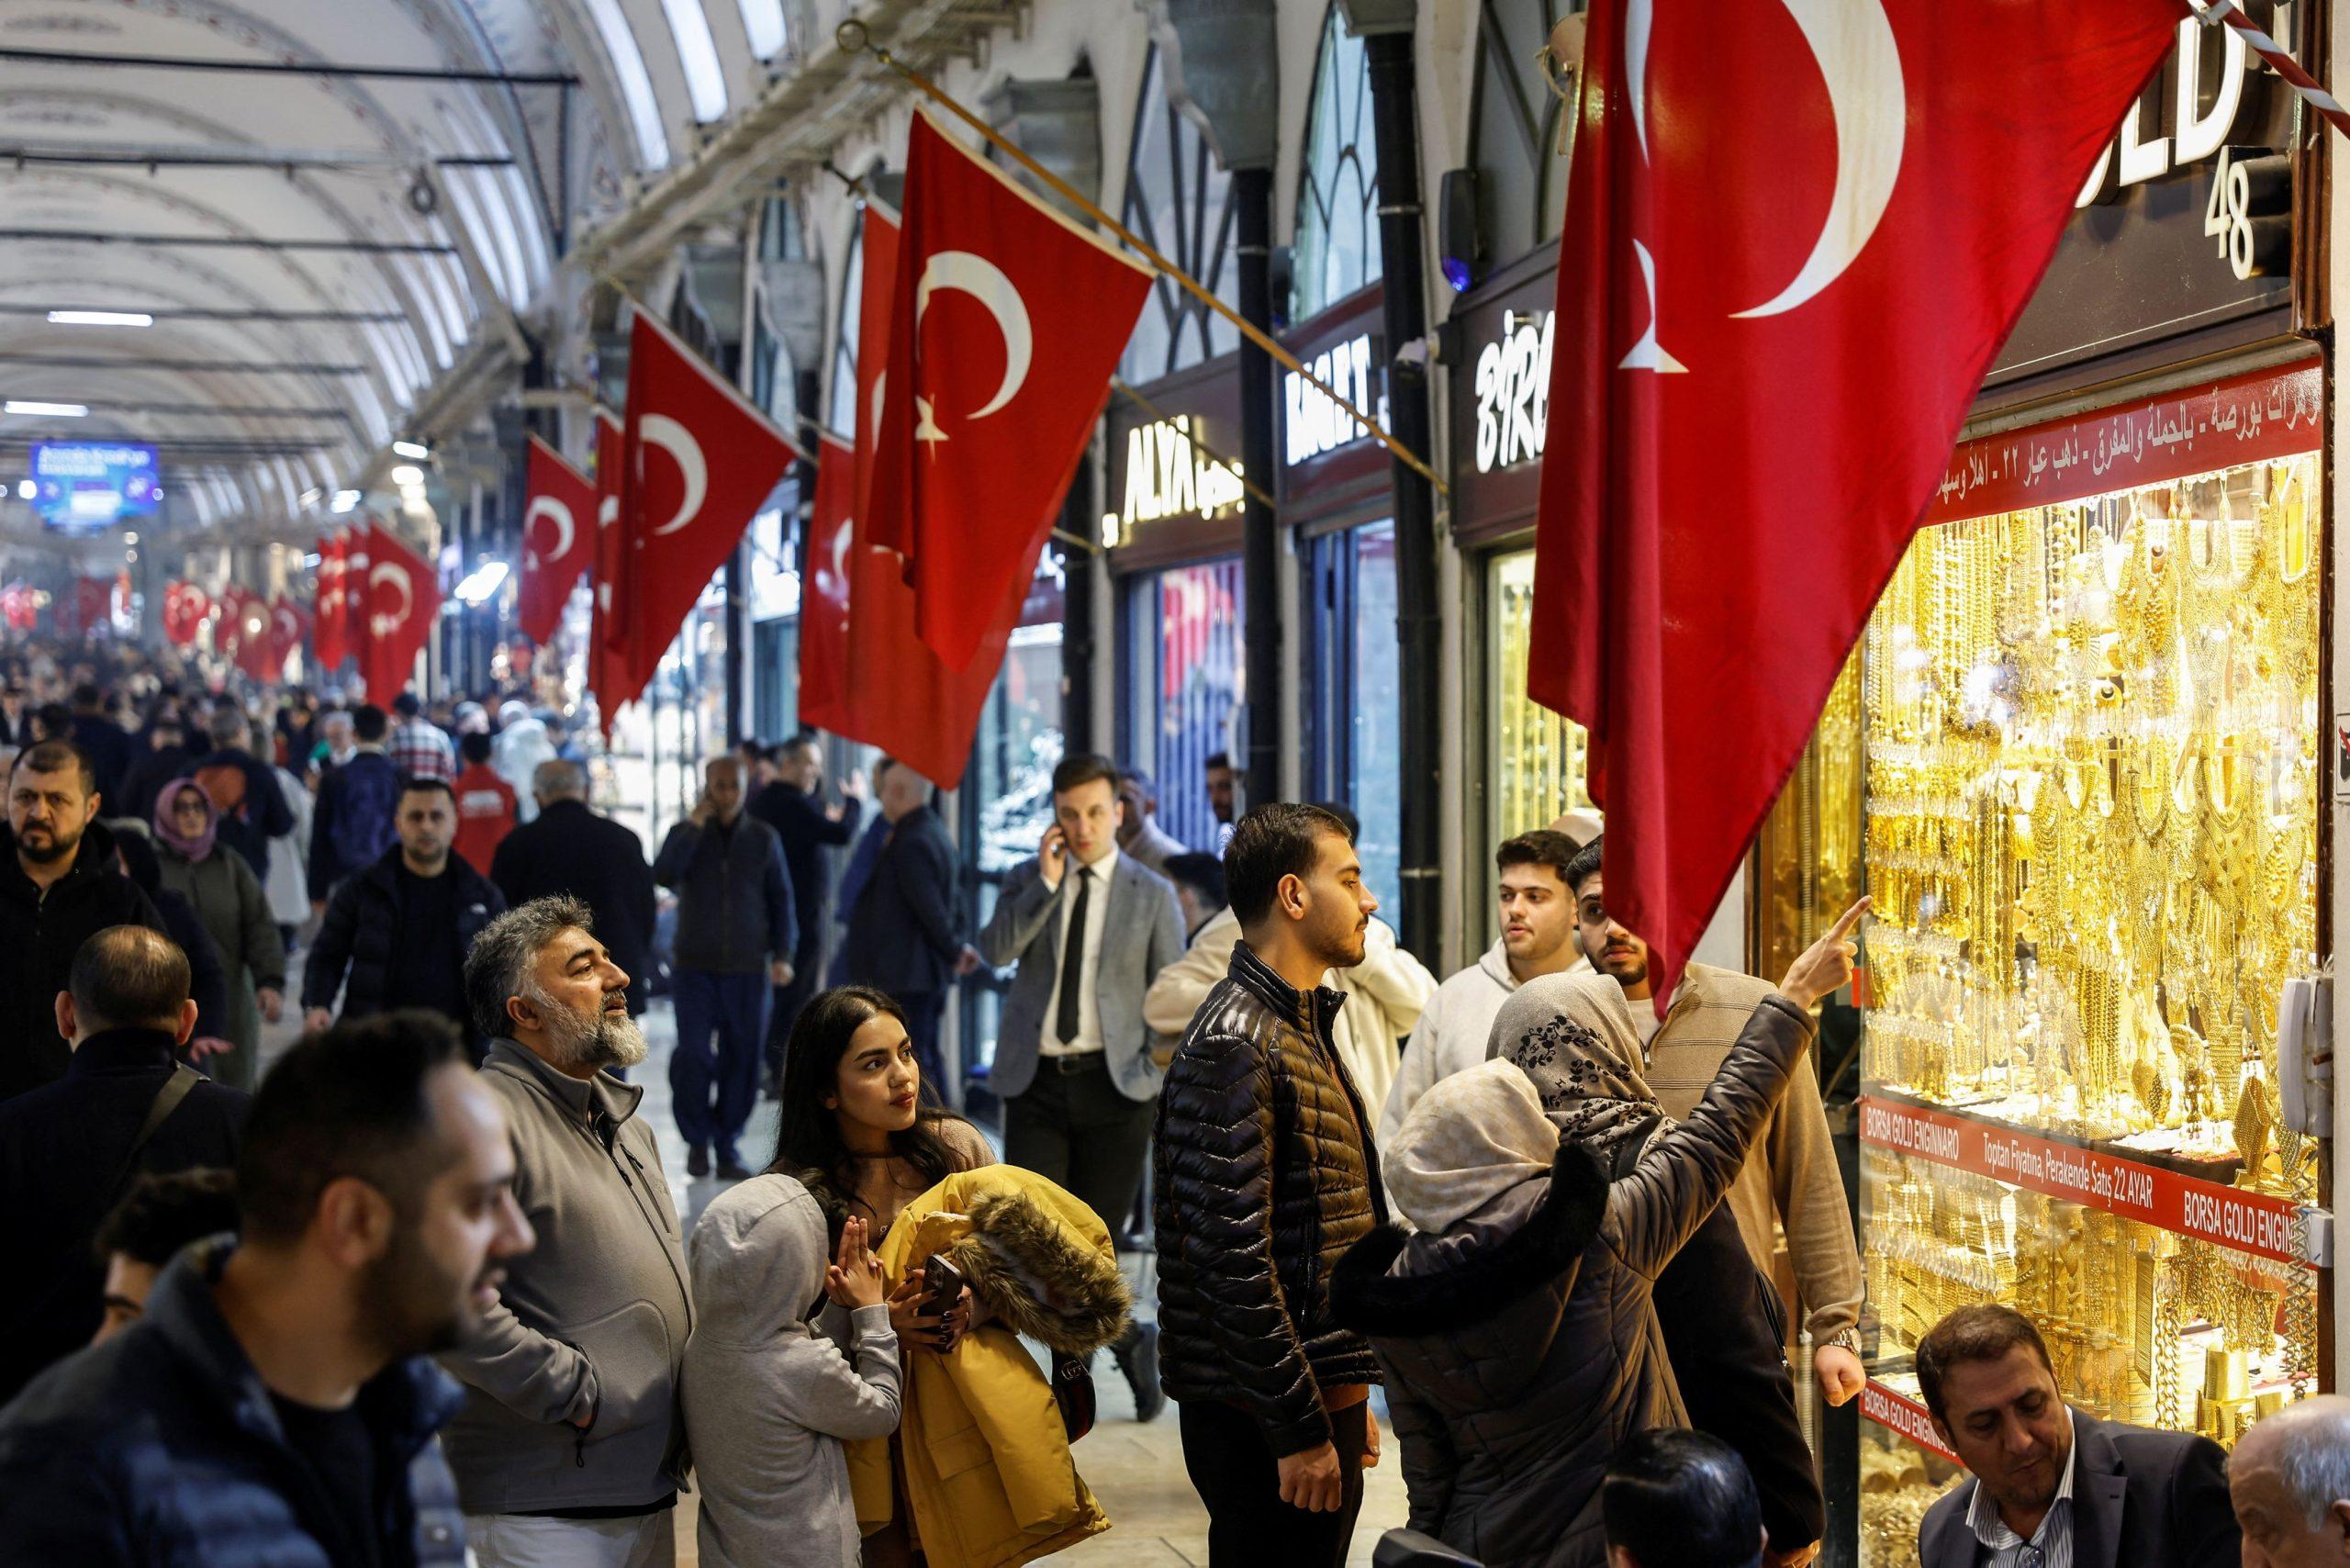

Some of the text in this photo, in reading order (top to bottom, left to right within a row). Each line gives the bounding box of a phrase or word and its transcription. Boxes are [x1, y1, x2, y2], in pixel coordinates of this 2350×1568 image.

[2205, 145, 2254, 280] 48
[2146, 401, 2194, 455] بالجملة
[2210, 386, 2262, 442] بورصة
[2023, 441, 2048, 487] عيار
[2053, 423, 2078, 480] ذهب
[1866, 1106, 1892, 1143] BORSA
[1892, 1114, 1913, 1148] GOLD
[1983, 1132, 2009, 1174] Toptan
[2045, 1148, 2089, 1192] Perakende
[2091, 1159, 2112, 1207] Satış
[2113, 1166, 2126, 1201] 22
[2127, 1170, 2154, 1209] AYAR
[2184, 1190, 2221, 1236] BORSA
[2223, 1201, 2255, 1244] GOLD
[1864, 1387, 1890, 1423] BORSA
[1890, 1401, 1911, 1433] GOLD
